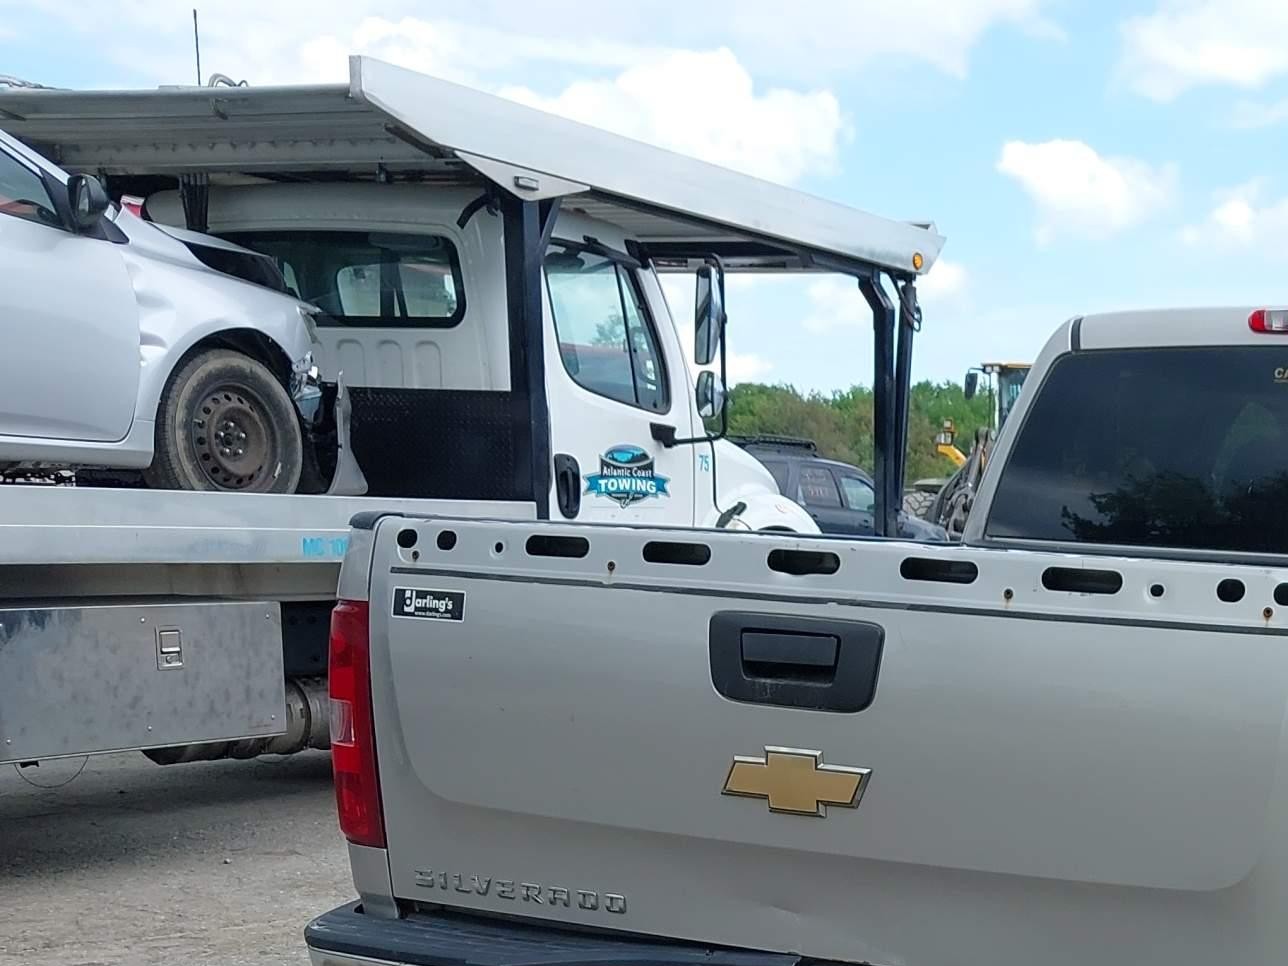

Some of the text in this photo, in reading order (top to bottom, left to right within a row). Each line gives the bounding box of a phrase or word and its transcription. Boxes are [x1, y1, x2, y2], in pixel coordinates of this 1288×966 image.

[699, 454, 710, 472] 75
[602, 466, 652, 479] Atlantic Coast
[597, 478, 657, 493] TOWING
[414, 868, 627, 914] SILVERADO
